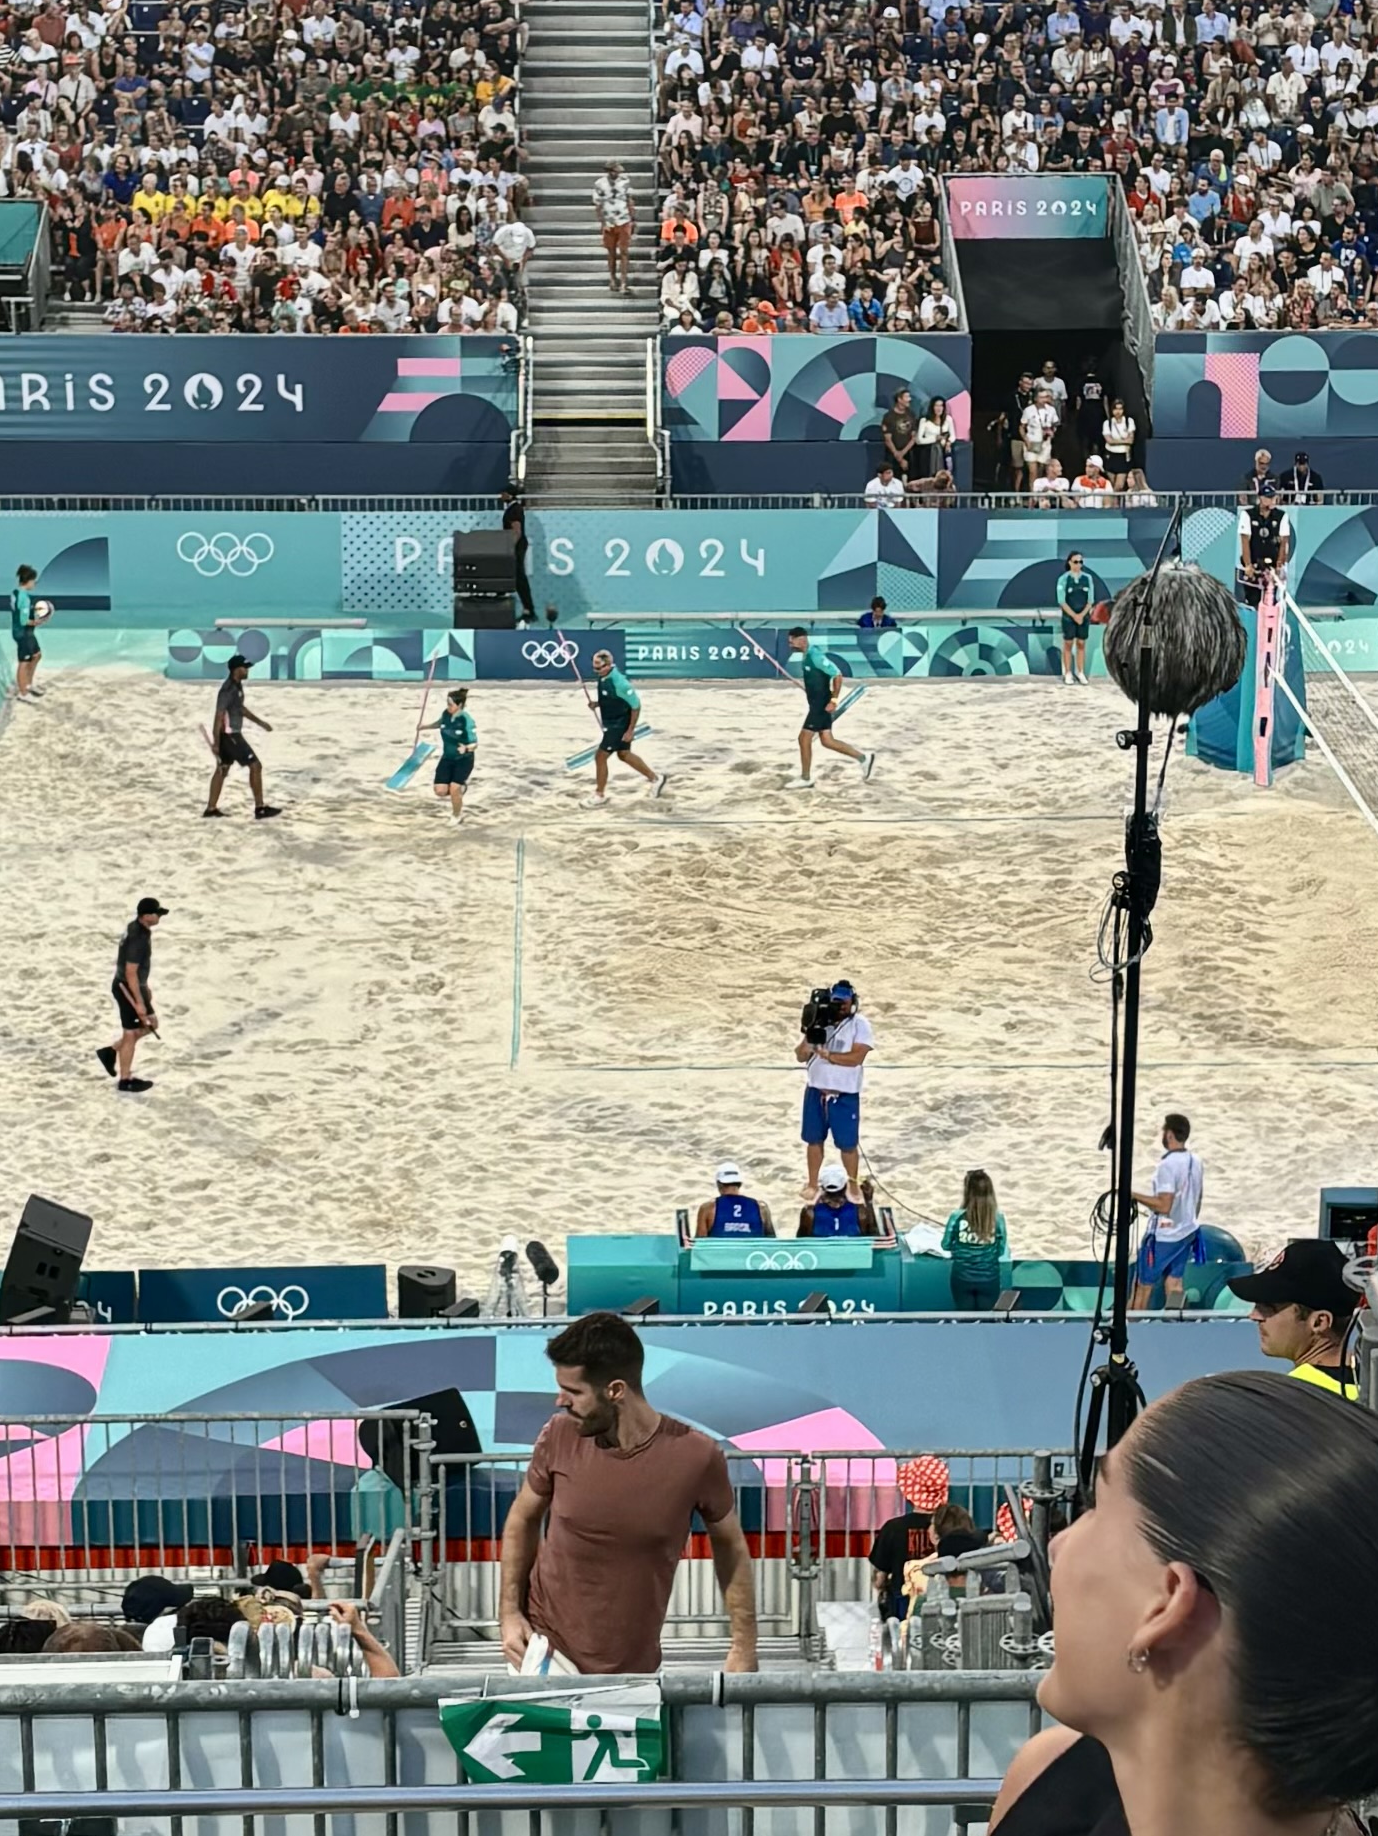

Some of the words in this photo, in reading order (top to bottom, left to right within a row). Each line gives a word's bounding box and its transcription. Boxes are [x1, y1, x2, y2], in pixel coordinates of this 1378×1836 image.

[1036, 200, 1097, 216] 2024
[143, 372, 304, 412] 2024
[604, 537, 765, 577] 2024
[733, 1204, 742, 1218] 2
[834, 1218, 840, 1231] 1
